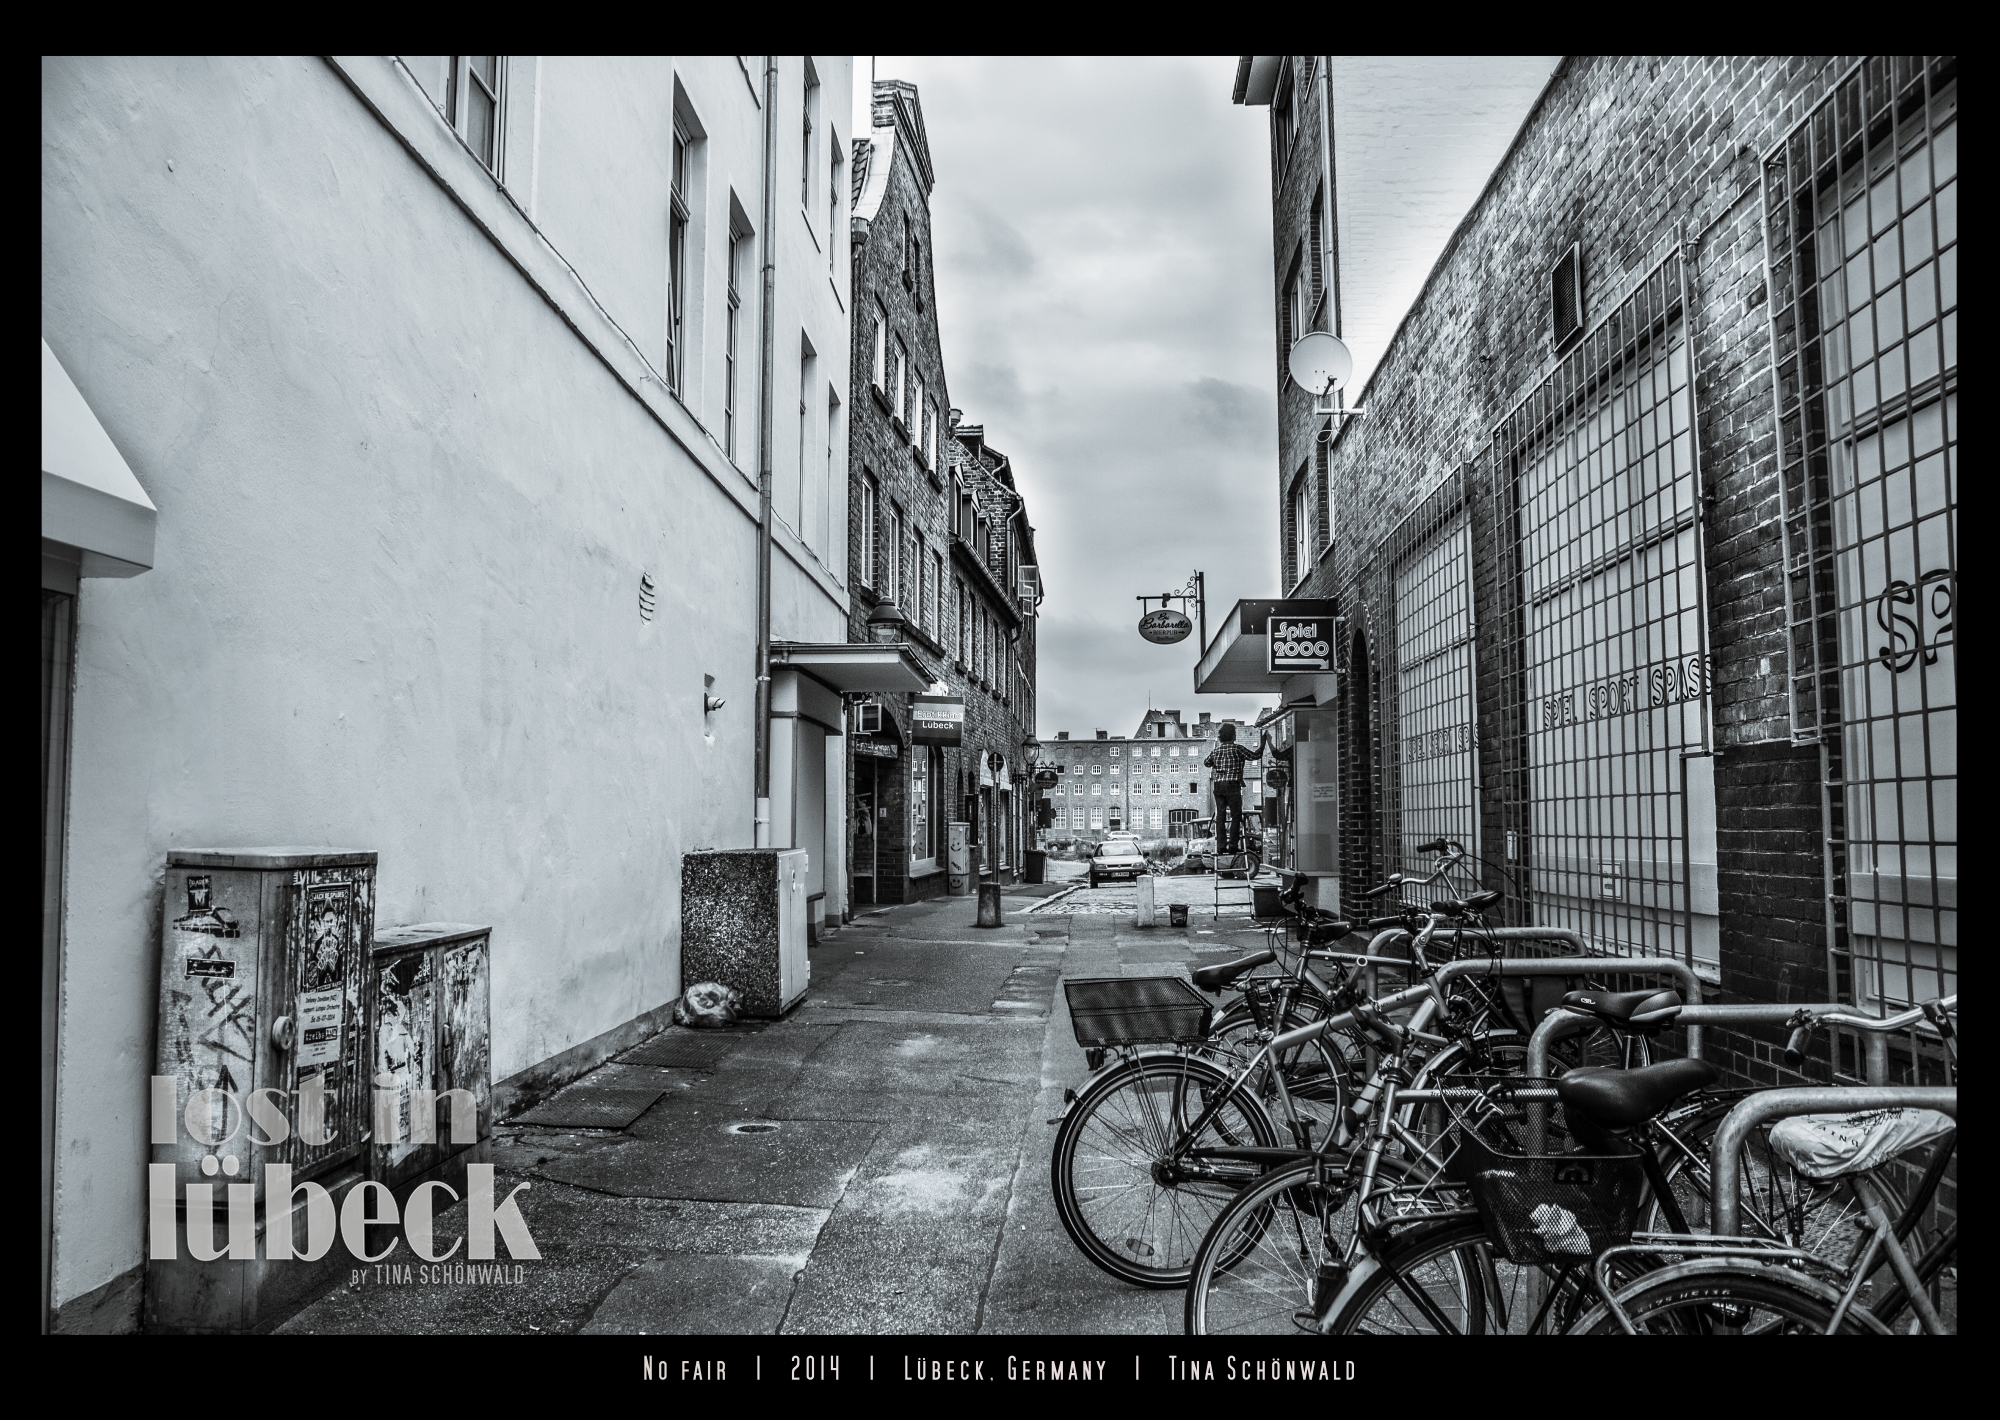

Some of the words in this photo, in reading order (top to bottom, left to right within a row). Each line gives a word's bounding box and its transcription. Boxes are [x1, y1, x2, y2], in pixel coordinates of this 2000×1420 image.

[1140, 617, 1190, 630] Barbarella
[1274, 621, 1317, 642] Spiel
[1273, 640, 1330, 657] 2000
[1588, 675, 1639, 720] SPORT
[922, 720, 954, 730] Lübeck
